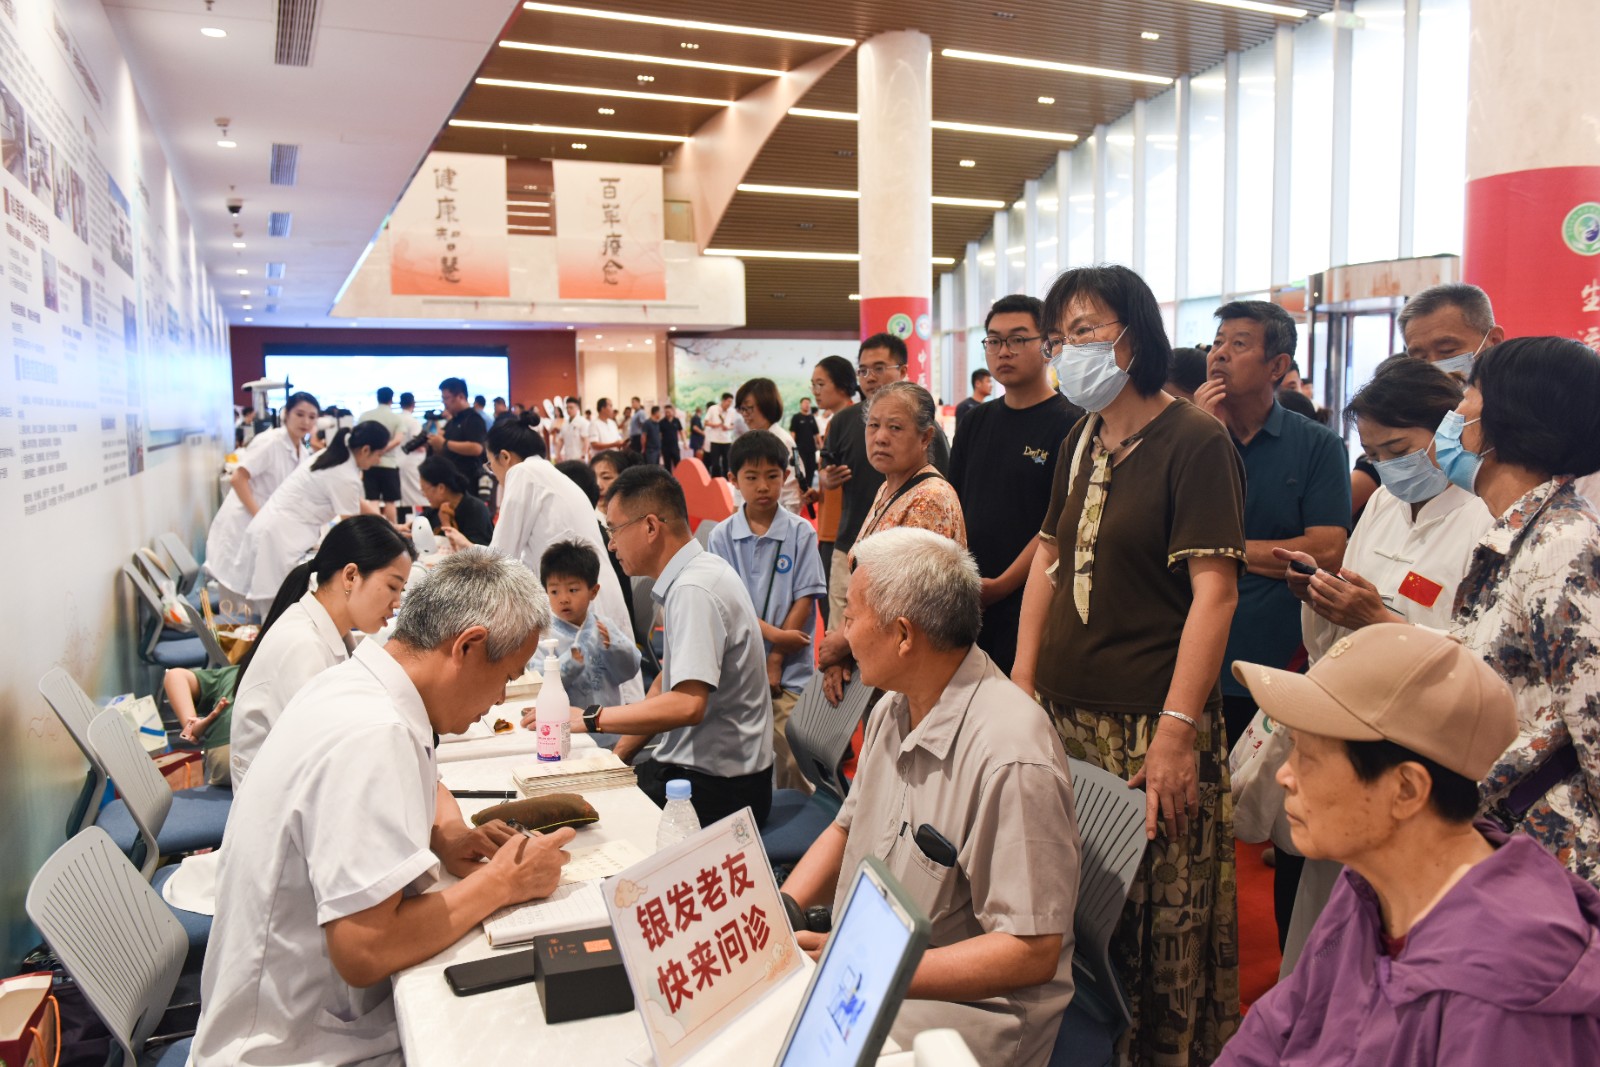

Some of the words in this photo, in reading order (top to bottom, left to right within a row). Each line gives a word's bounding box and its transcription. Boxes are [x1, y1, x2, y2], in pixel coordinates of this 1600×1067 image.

[637, 852, 755, 951] 银发老友
[657, 905, 770, 1014] 快来问诊
